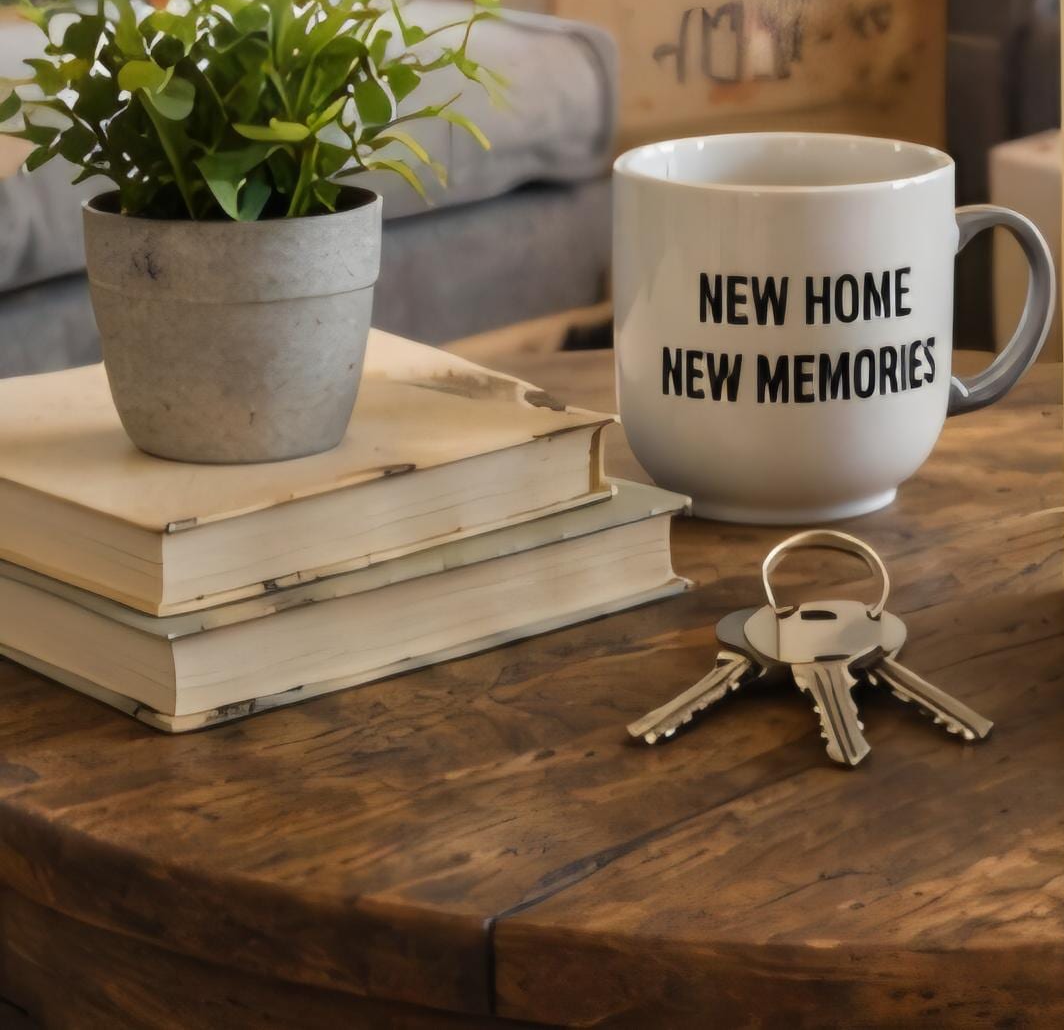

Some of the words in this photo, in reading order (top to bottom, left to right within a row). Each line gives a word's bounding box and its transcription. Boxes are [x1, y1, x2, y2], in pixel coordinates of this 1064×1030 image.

[699, 272, 789, 326] NEW
[804, 266, 912, 326] HOME
[661, 346, 743, 403] NEW
[756, 336, 936, 404] MEMORIES
